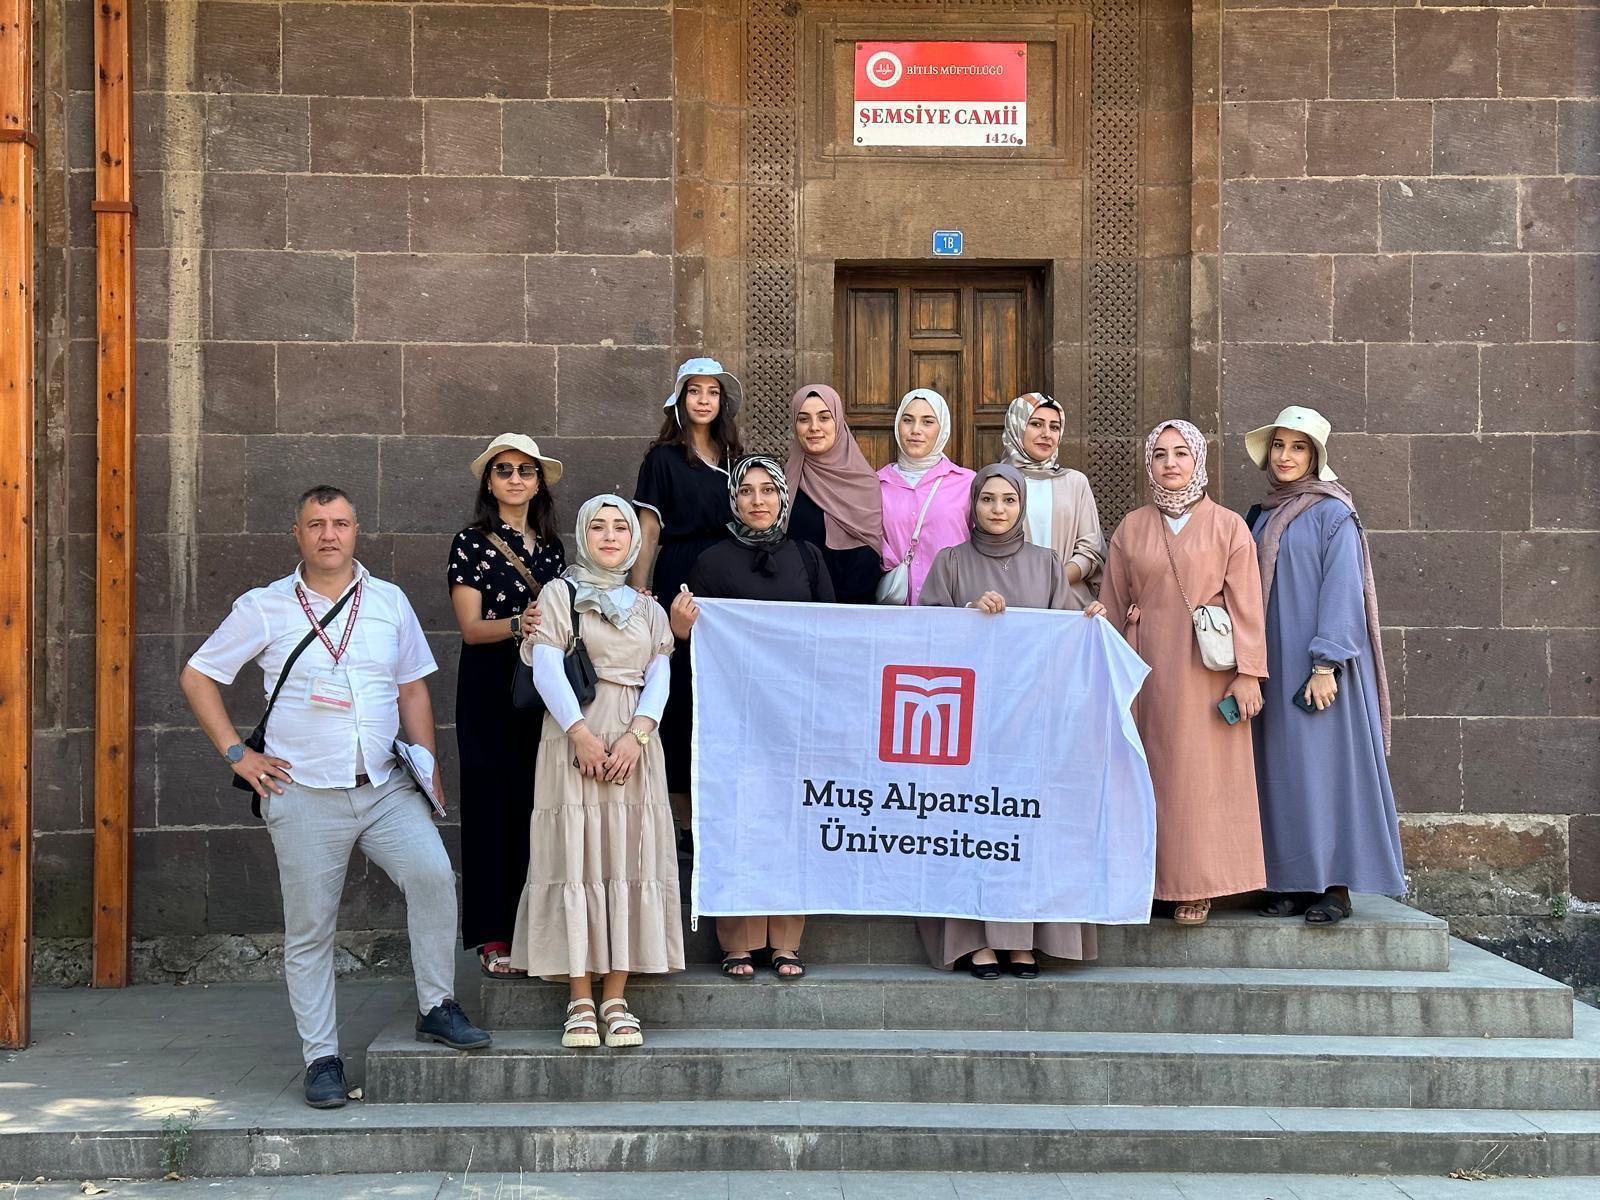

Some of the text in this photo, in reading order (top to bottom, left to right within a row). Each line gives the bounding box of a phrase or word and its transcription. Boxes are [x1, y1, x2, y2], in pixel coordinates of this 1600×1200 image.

[906, 64, 1004, 76] BİTLİS MÜFTÜLÜĞÜ
[859, 104, 1018, 127] ŞEMSİYE CAMİİ
[985, 133, 1017, 144] 1426
[802, 779, 1041, 820] Muş Alparslan
[820, 818, 1021, 862] Üniversitesi
